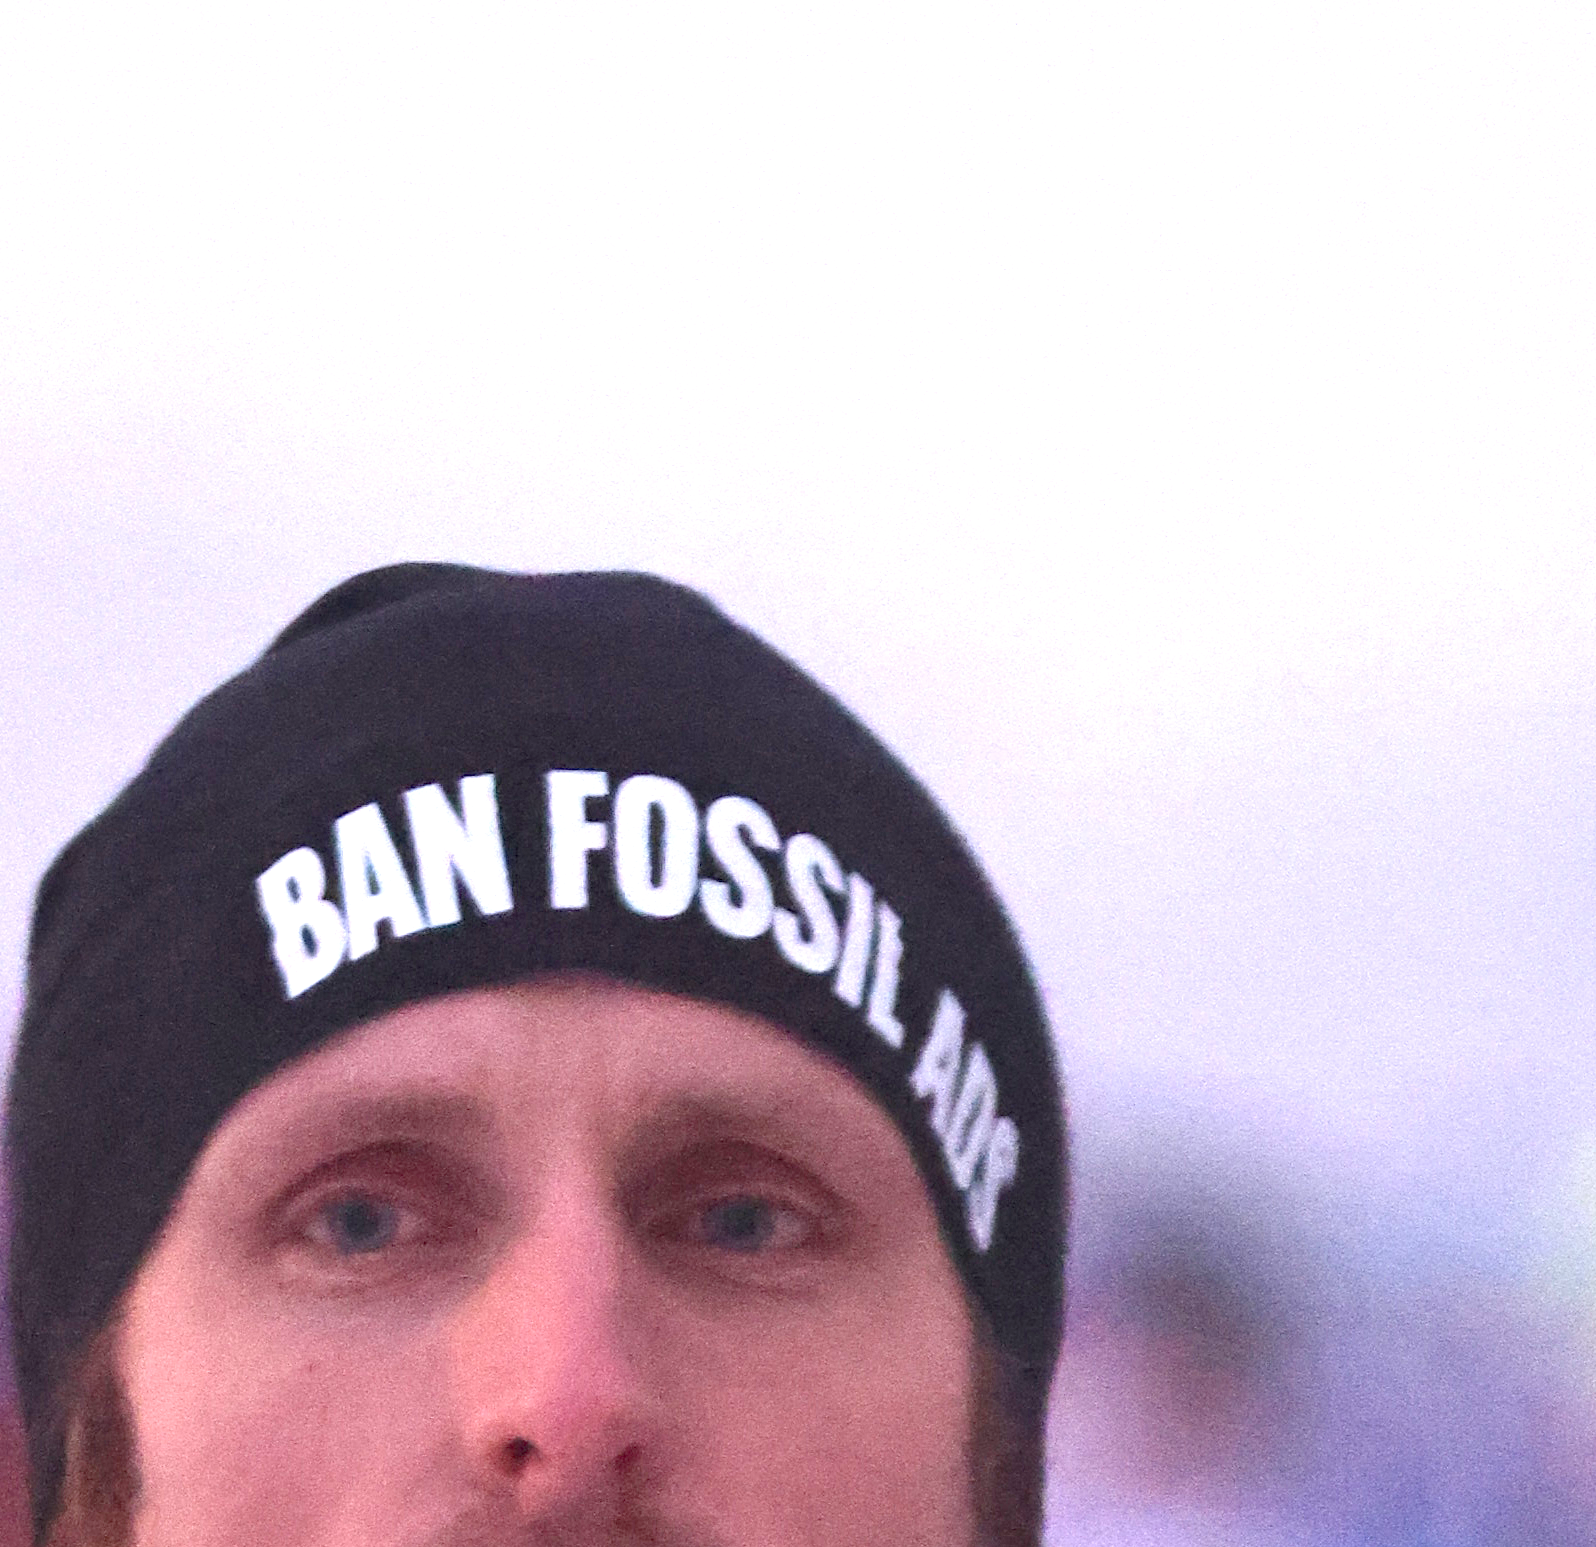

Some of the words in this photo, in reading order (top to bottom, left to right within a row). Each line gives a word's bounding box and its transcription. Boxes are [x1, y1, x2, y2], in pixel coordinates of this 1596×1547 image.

[255, 772, 514, 1000] BAN
[544, 768, 907, 1049] FOSSIL
[909, 988, 1020, 1252] ADS
